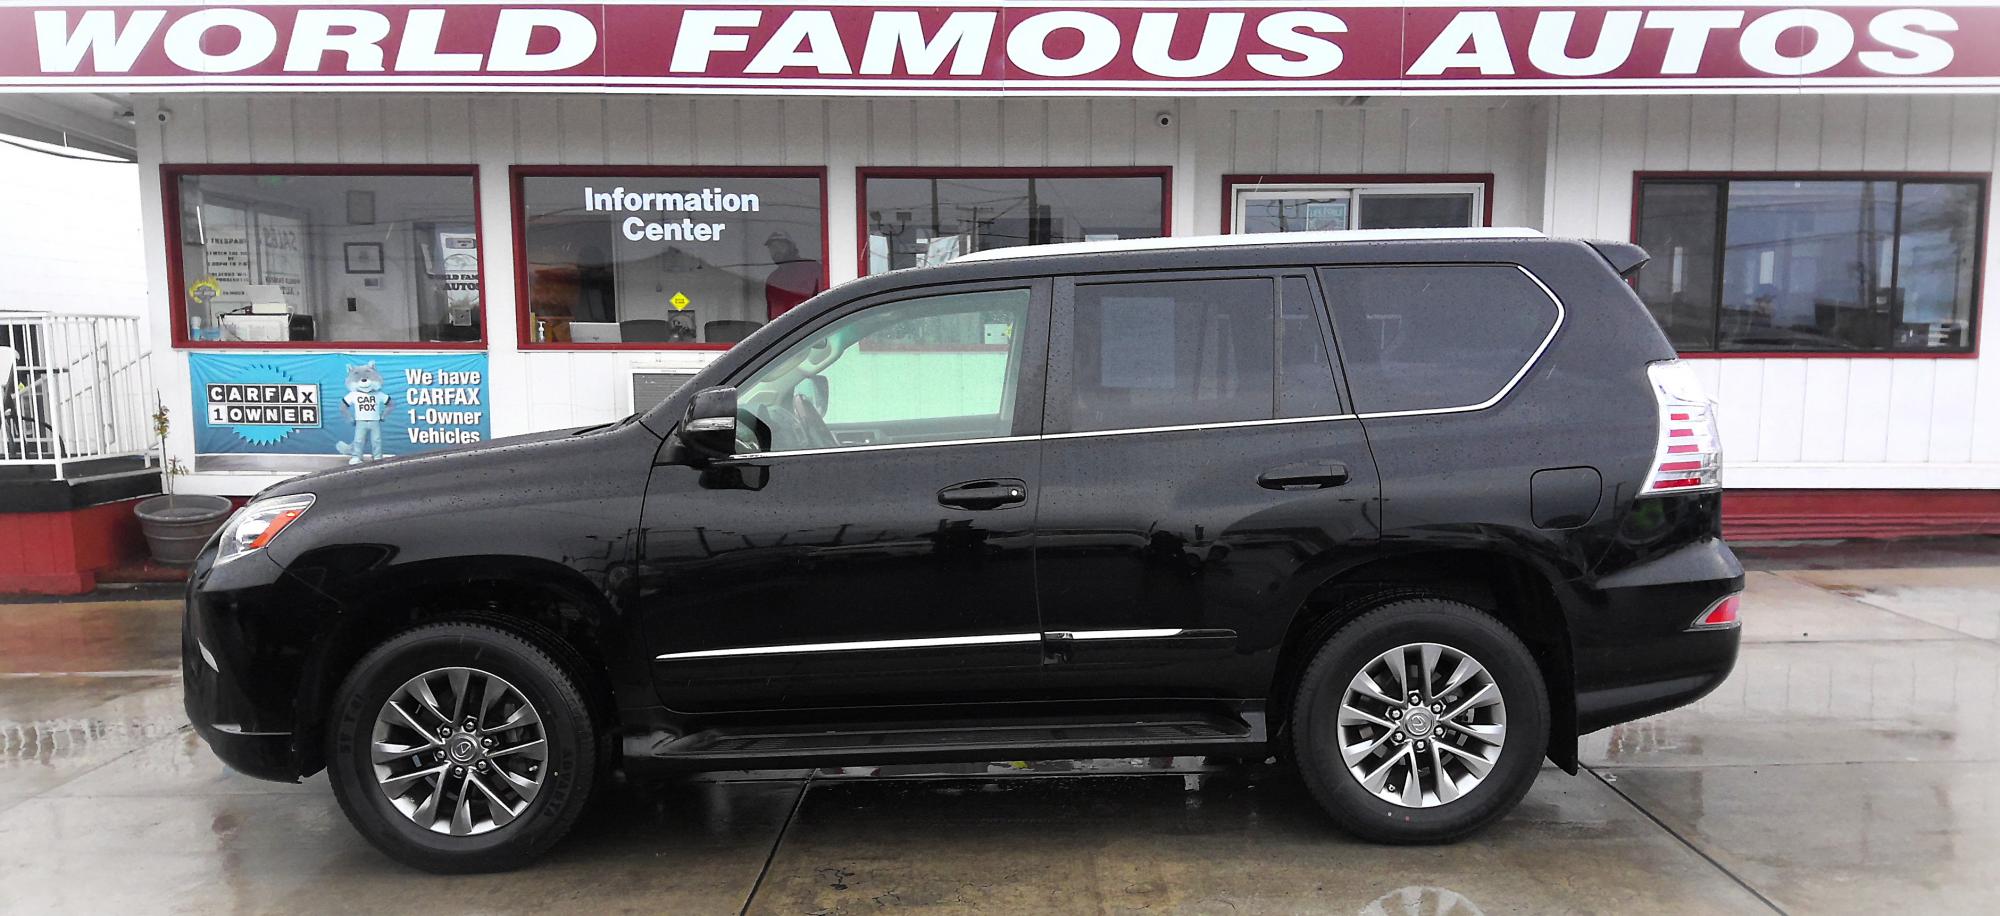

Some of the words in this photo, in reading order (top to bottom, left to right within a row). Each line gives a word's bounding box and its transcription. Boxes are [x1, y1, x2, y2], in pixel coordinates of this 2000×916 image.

[35, 9, 597, 73] WORLD
[669, 10, 1348, 77] FAMOUS
[1405, 8, 1959, 76] AUTOS
[584, 187, 760, 212] Information
[622, 216, 726, 241] Center
[405, 368, 433, 386] We
[438, 368, 481, 386] have
[209, 387, 314, 404] CARFAX
[357, 395, 376, 404] CAR
[406, 387, 481, 406] CARFAX
[213, 408, 223, 421] 1
[229, 408, 315, 422] OWNER
[359, 403, 376, 412] FOX
[407, 408, 482, 425] 1-Owner
[407, 427, 480, 444] Vehicles
